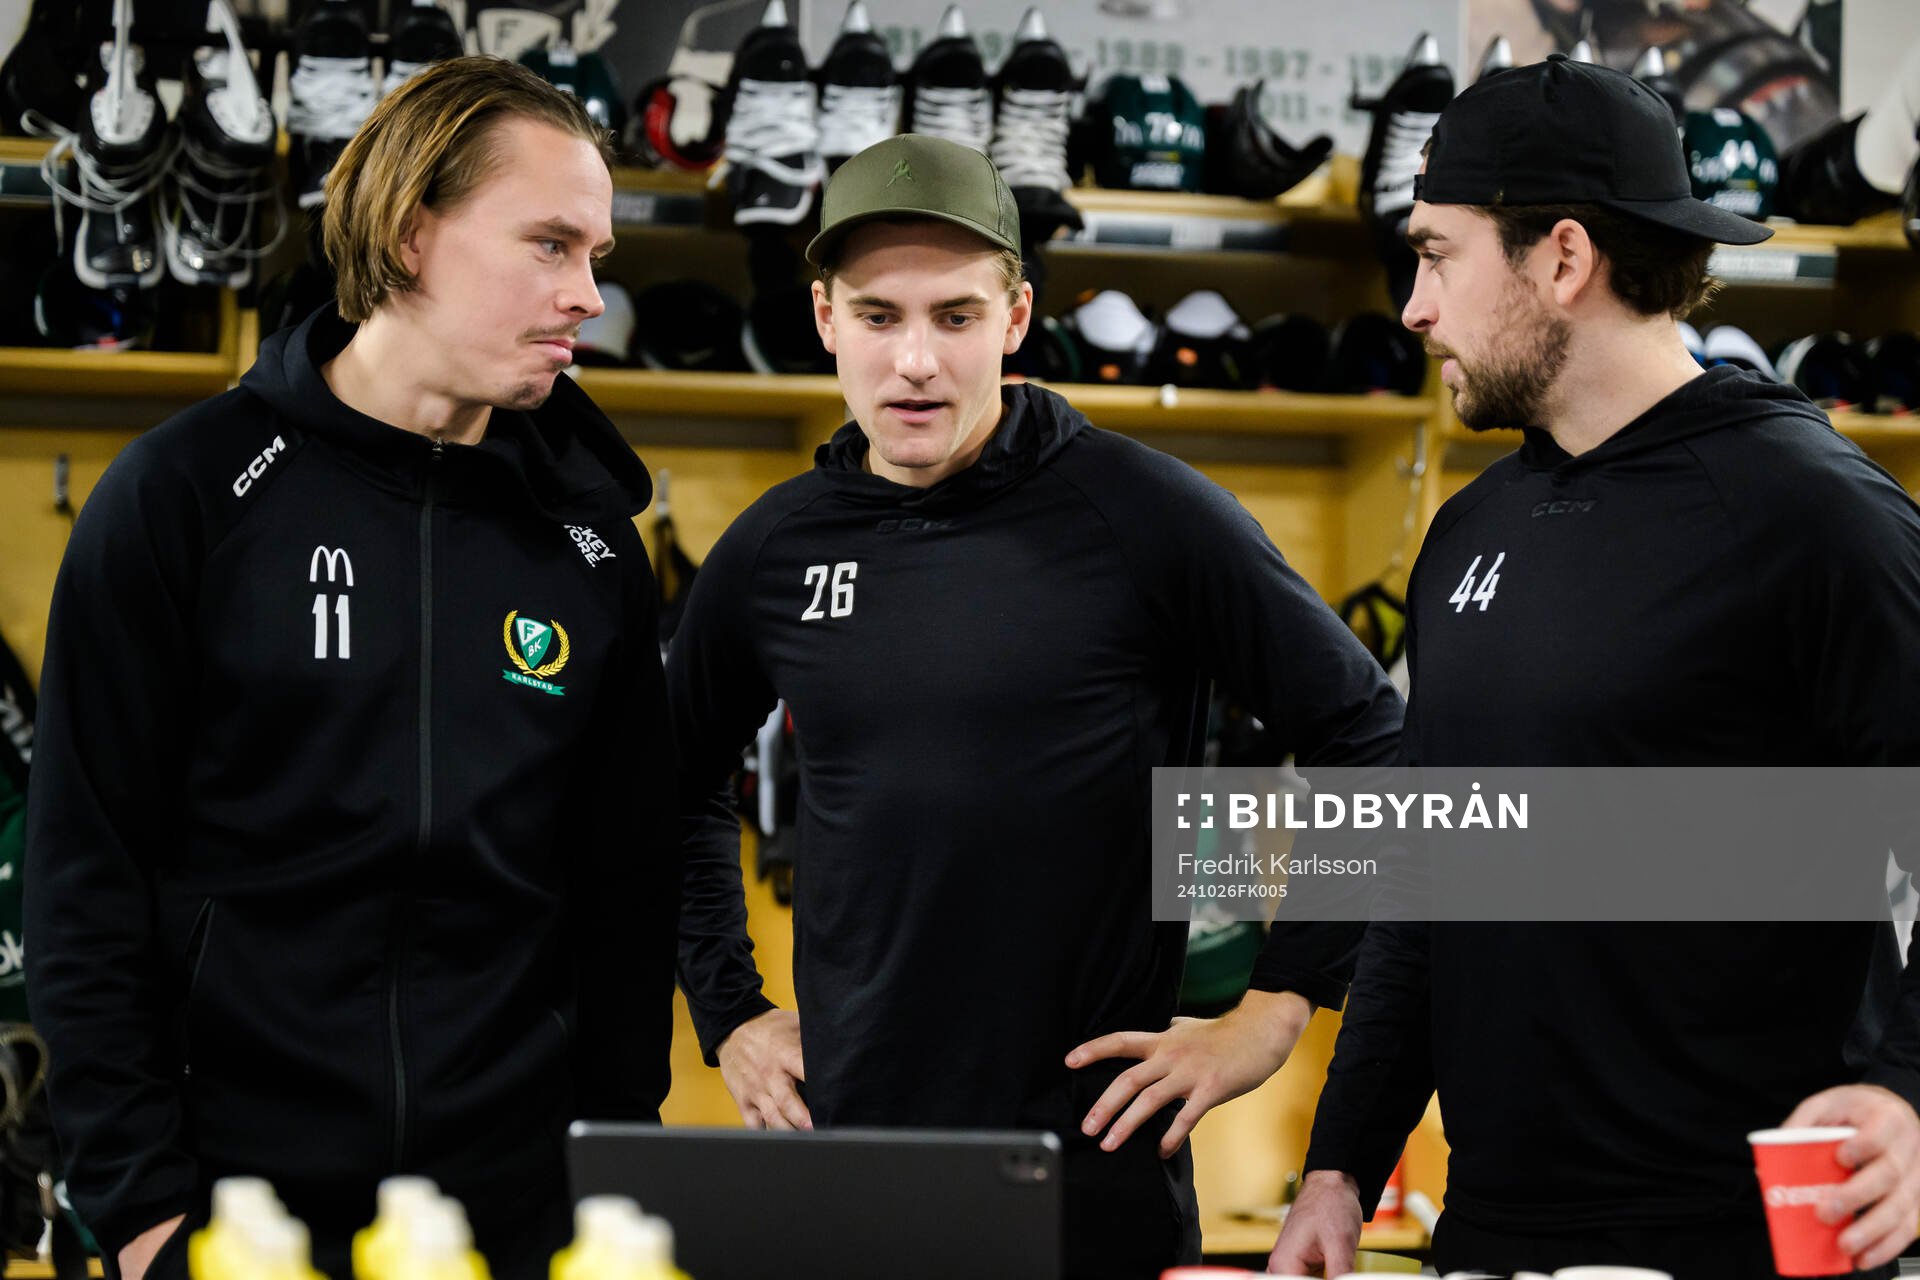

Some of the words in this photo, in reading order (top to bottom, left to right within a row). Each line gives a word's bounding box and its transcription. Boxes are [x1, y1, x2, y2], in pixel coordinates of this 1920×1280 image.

[232, 435, 286, 497] CCM
[581, 526, 616, 559] KEY
[801, 561, 858, 621] 26
[1448, 551, 1506, 613] 44
[312, 594, 350, 659] 11
[523, 622, 536, 641] F
[528, 637, 542, 658] BK
[511, 672, 553, 691] KARLSTAD
